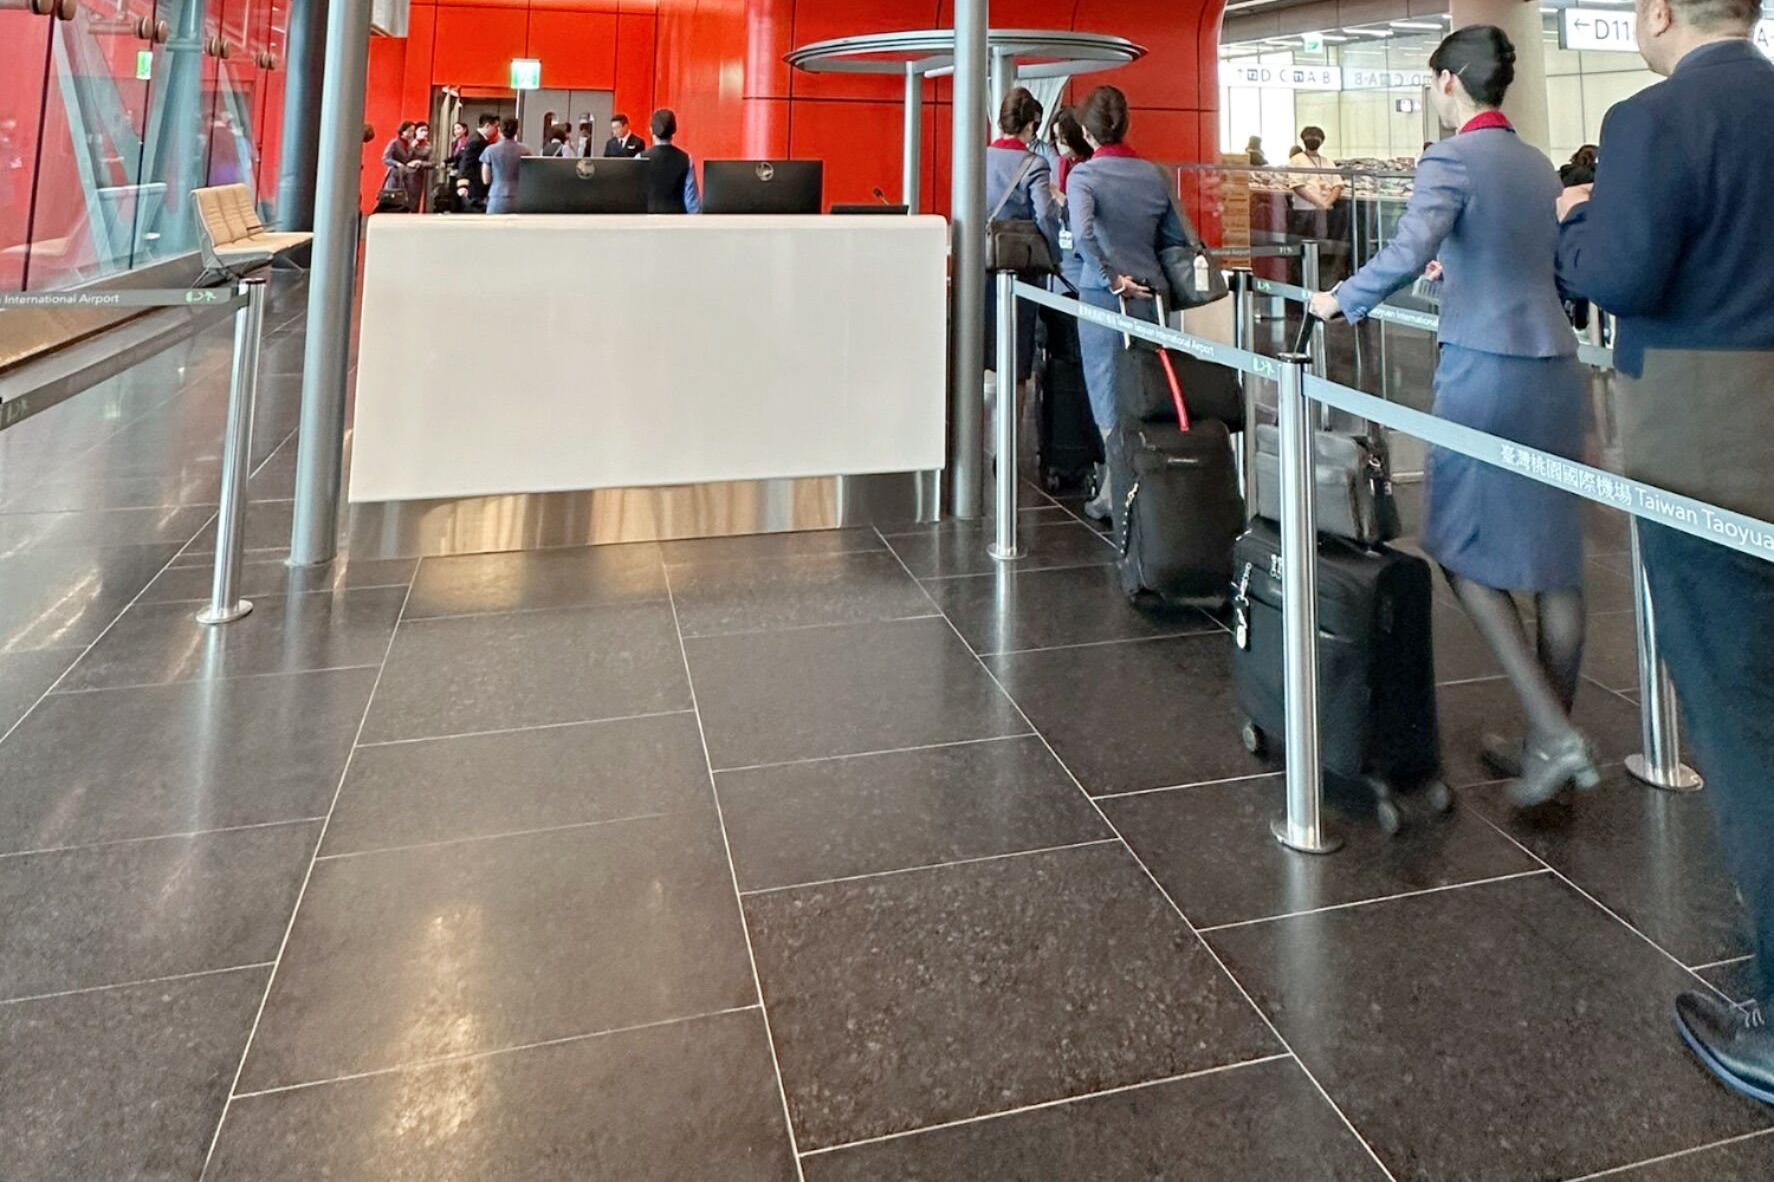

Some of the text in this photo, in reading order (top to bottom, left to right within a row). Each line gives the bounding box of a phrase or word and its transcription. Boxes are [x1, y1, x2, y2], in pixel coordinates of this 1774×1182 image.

[1594, 18, 1631, 41] D11
[4, 293, 120, 306] International Airport
[1634, 485, 1699, 525] Taiwan
